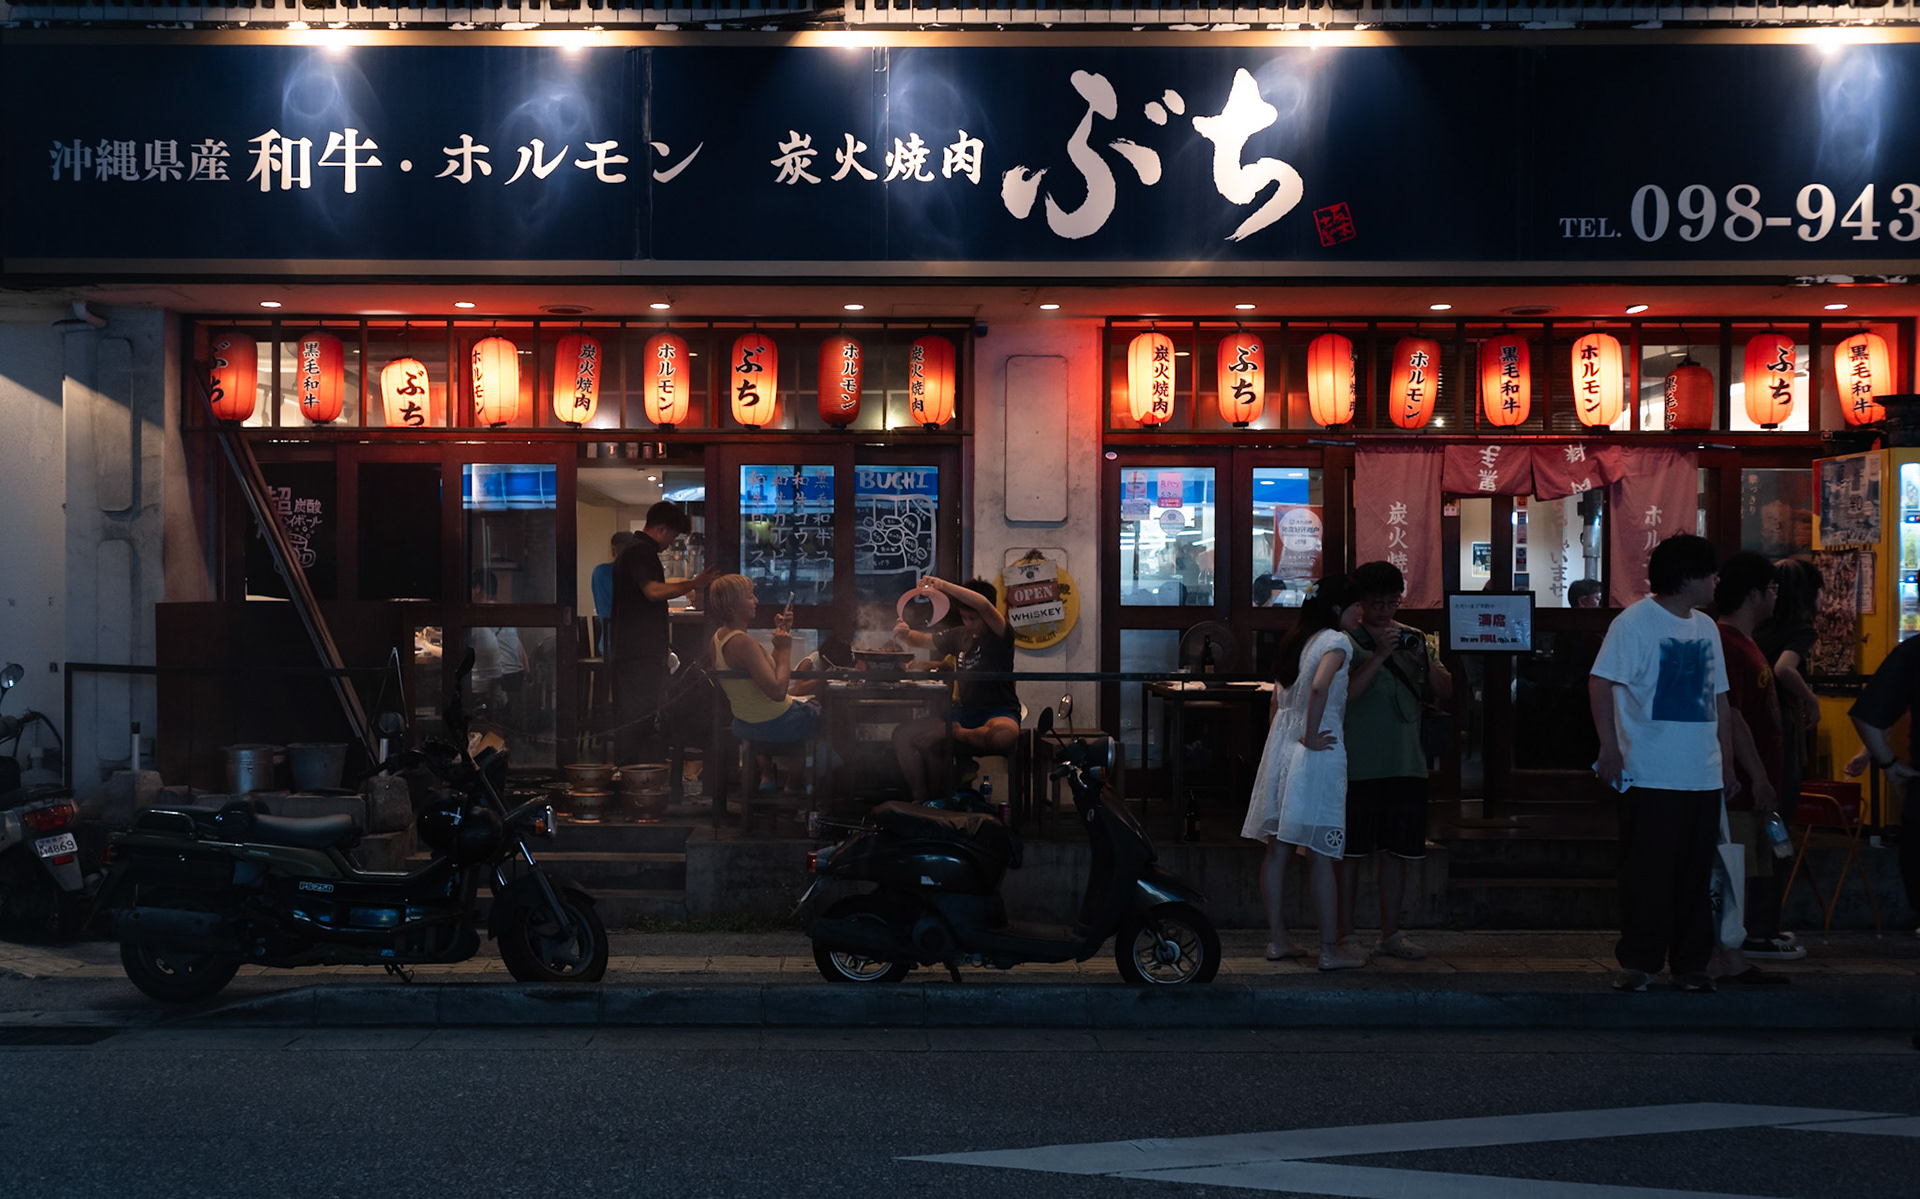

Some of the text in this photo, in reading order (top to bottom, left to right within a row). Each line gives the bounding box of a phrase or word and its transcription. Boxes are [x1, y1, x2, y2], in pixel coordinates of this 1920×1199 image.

[50, 138, 230, 182] 沖縄県産
[771, 68, 1304, 241] 炭火焼肉 ぶち
[1560, 184, 1920, 242] TEL. 098-943
[302, 341, 321, 409] 黒毛和牛
[397, 370, 426, 427] ぶち
[472, 349, 485, 415] ホルモン
[574, 343, 597, 411] 炭火焼肉
[656, 342, 676, 411] ホルモン
[735, 345, 764, 407] ぶち
[840, 342, 859, 411] ホルモン
[910, 345, 924, 413] 炭火焼肉
[1152, 345, 1171, 415] 炭火焼肉
[1228, 344, 1260, 405] ぶち
[1405, 350, 1430, 420] ホルモン
[1501, 345, 1521, 415] 黒毛和牛
[1580, 344, 1600, 413] ホルモン
[1767, 344, 1795, 406] ぶち
[1850, 344, 1873, 414] 黒毛和牛
[294, 497, 323, 514] 炭酸
[858, 470, 929, 489] BUCHI
[1386, 501, 1409, 598] 炭火焼
[1011, 607, 1061, 621] WHISKEY
[1014, 585, 1053, 602] OPEN
[1478, 613, 1506, 627] 満席
[1480, 634, 1496, 643] FULL
[299, 880, 335, 894] PS250
